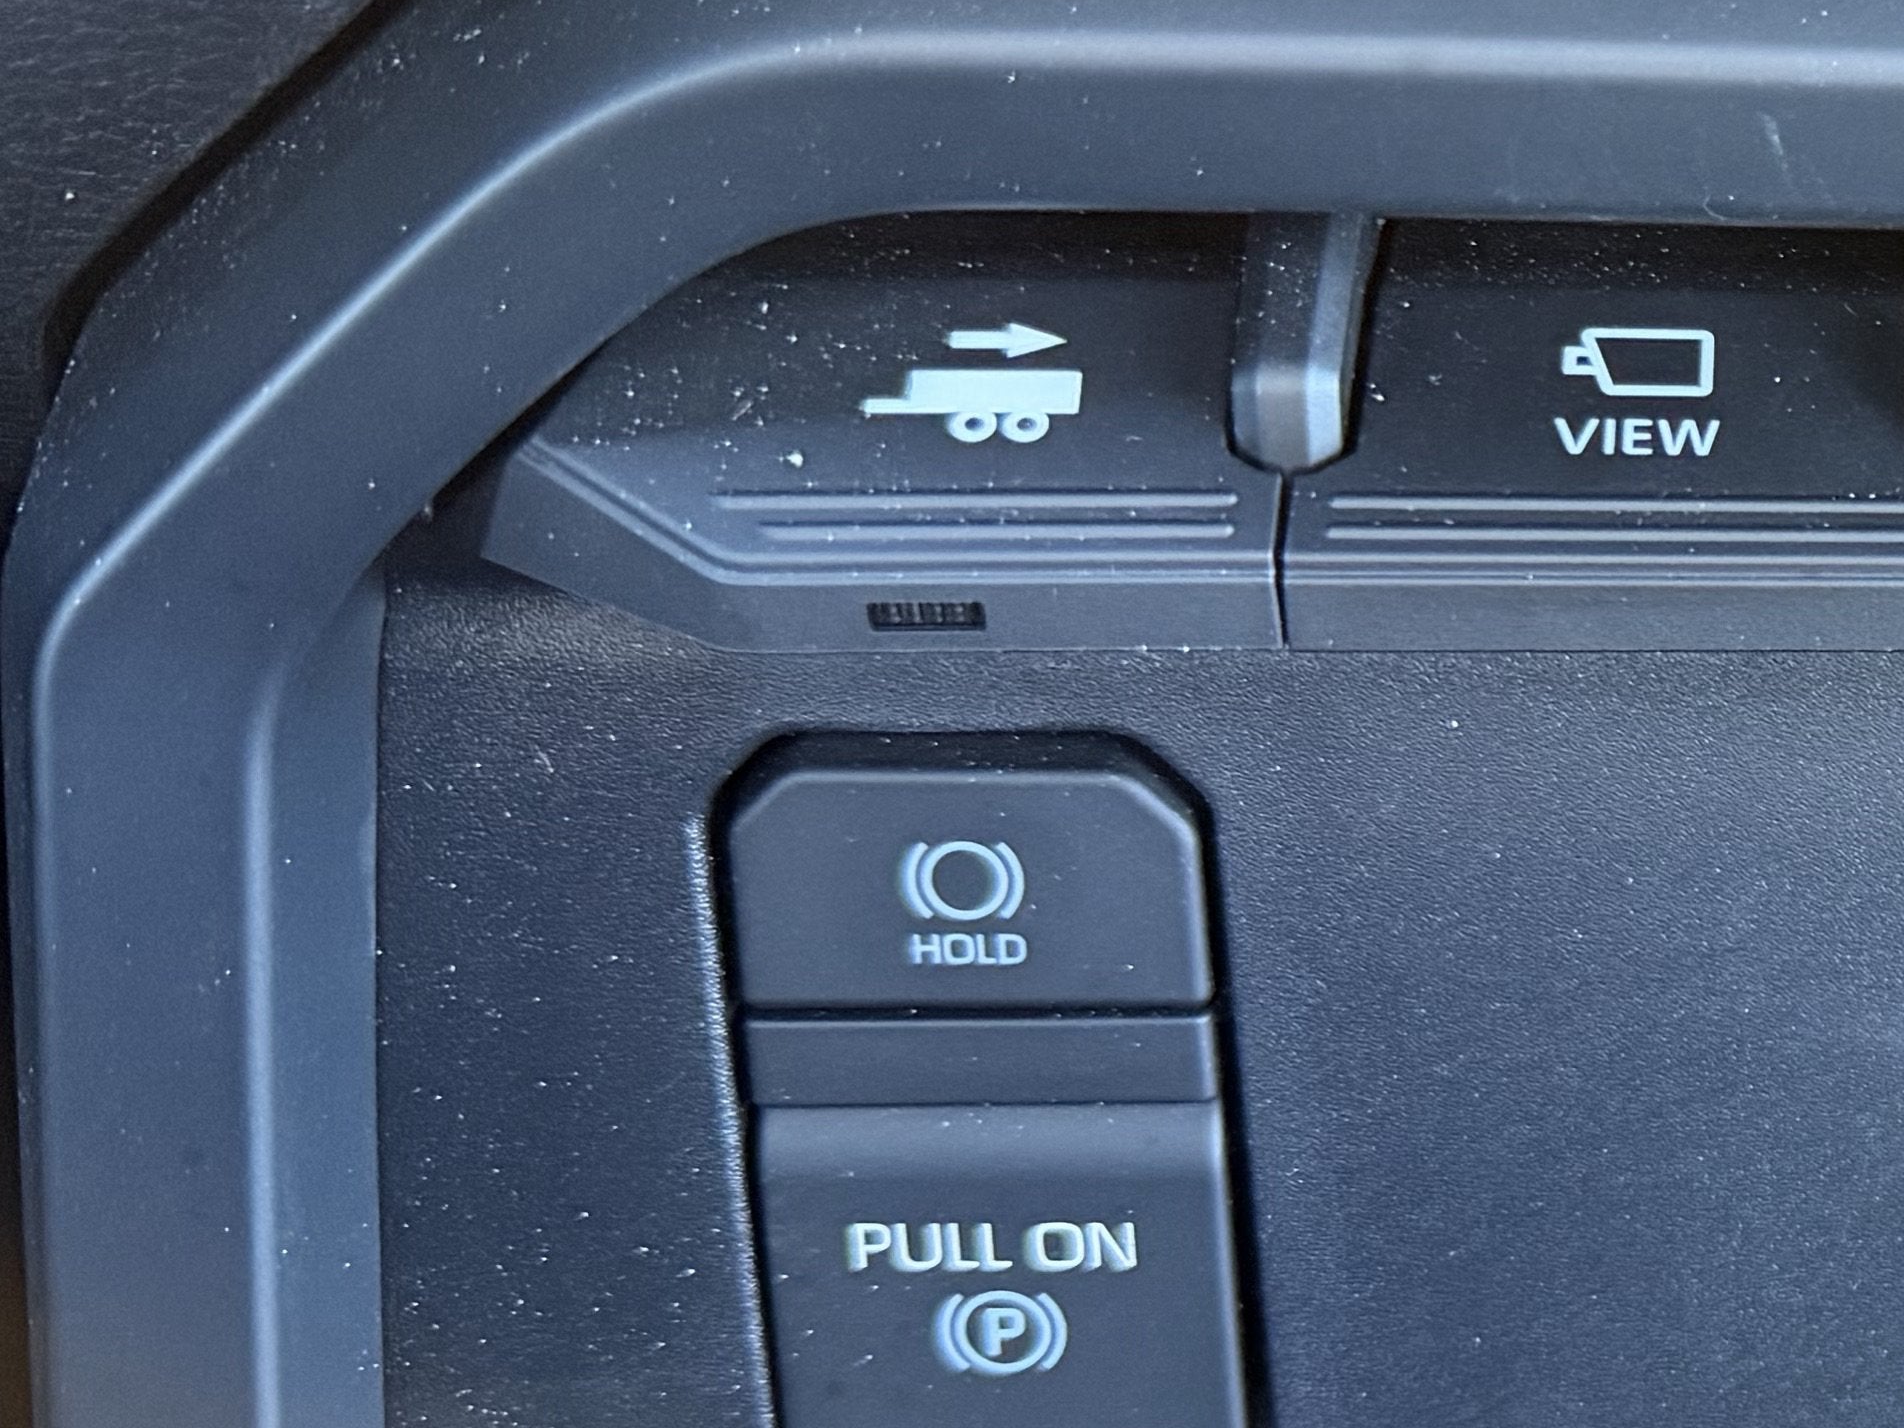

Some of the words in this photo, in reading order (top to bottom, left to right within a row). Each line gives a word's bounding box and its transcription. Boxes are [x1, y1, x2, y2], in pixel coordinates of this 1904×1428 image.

[1553, 417, 1721, 457] VIEW
[908, 932, 1028, 966] HOLD
[844, 1222, 1013, 1272] PULL
[1022, 1222, 1138, 1272] ON
[981, 1307, 1026, 1357] P
